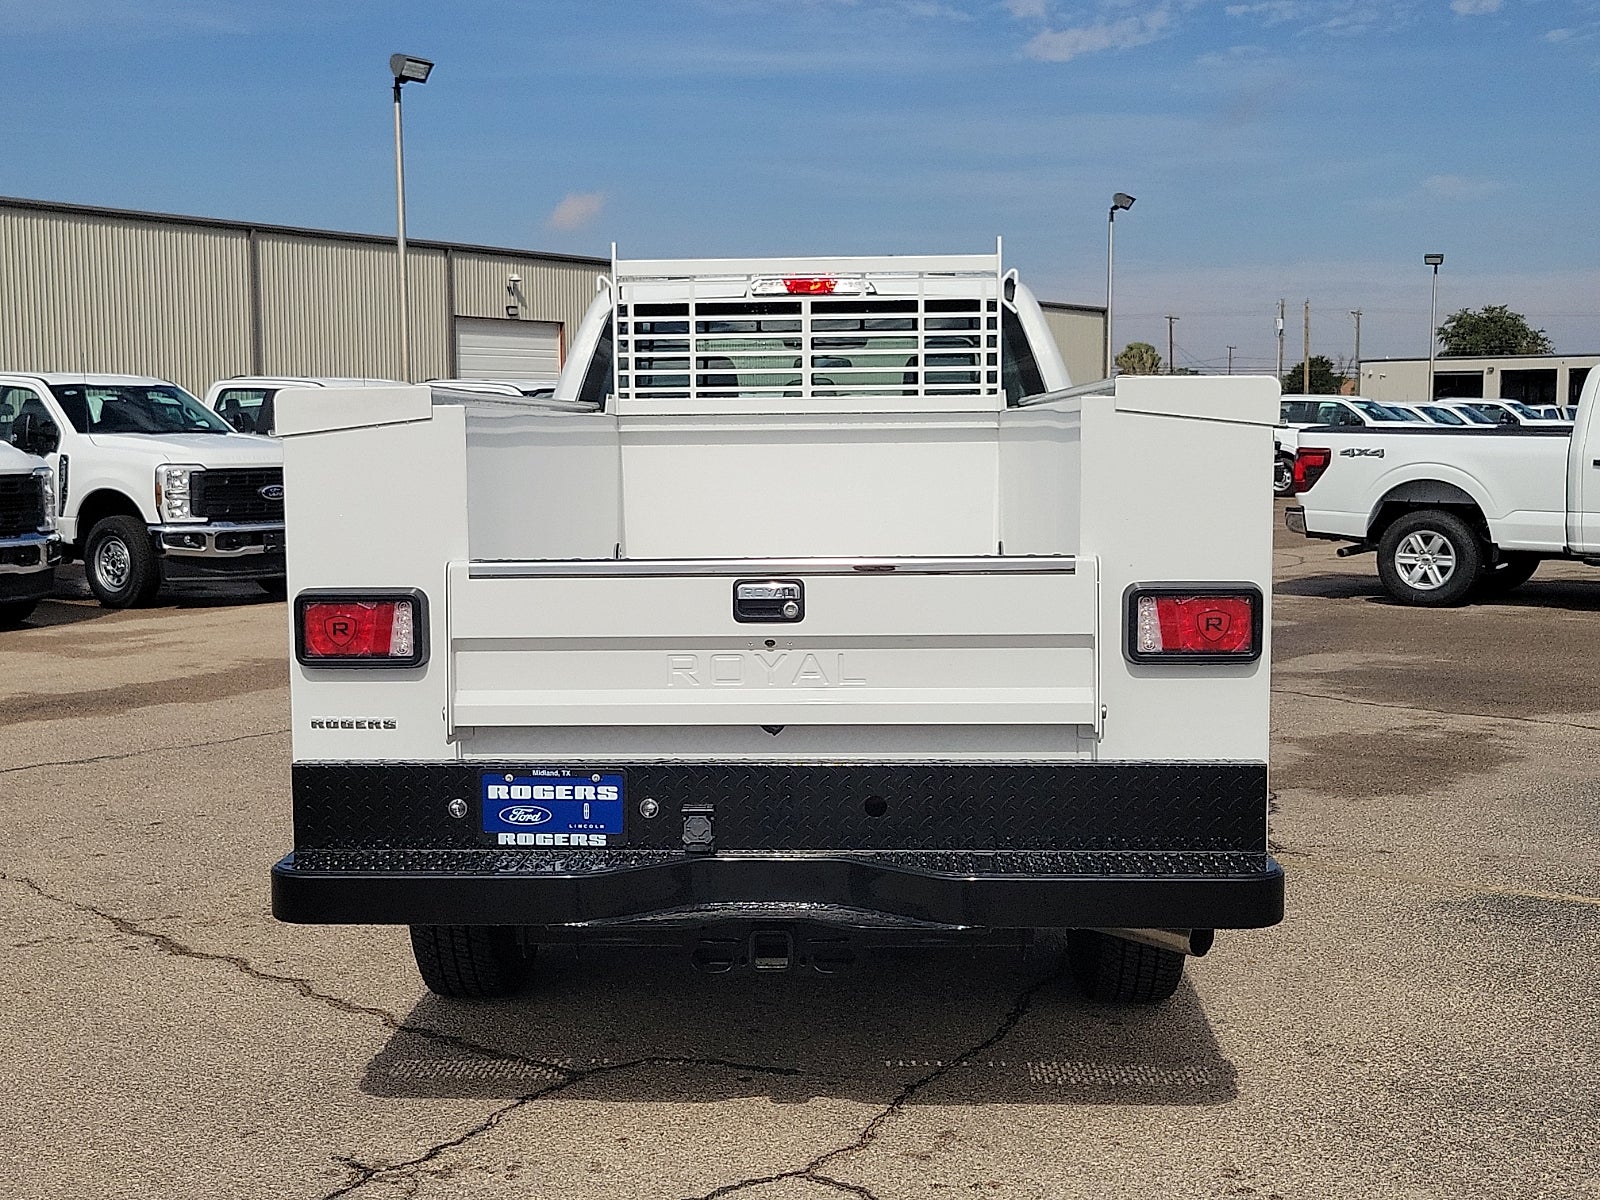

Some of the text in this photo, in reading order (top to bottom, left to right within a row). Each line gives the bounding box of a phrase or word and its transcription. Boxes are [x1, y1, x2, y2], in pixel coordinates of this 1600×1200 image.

[332, 622, 349, 636] R
[1205, 617, 1223, 631] R
[667, 653, 866, 686] ROYAL
[310, 718, 397, 730] ROGERS
[532, 769, 571, 777] Midland, TX
[487, 785, 618, 800] ROGERS
[508, 807, 541, 822] Ford
[498, 833, 607, 846] ROGERS
